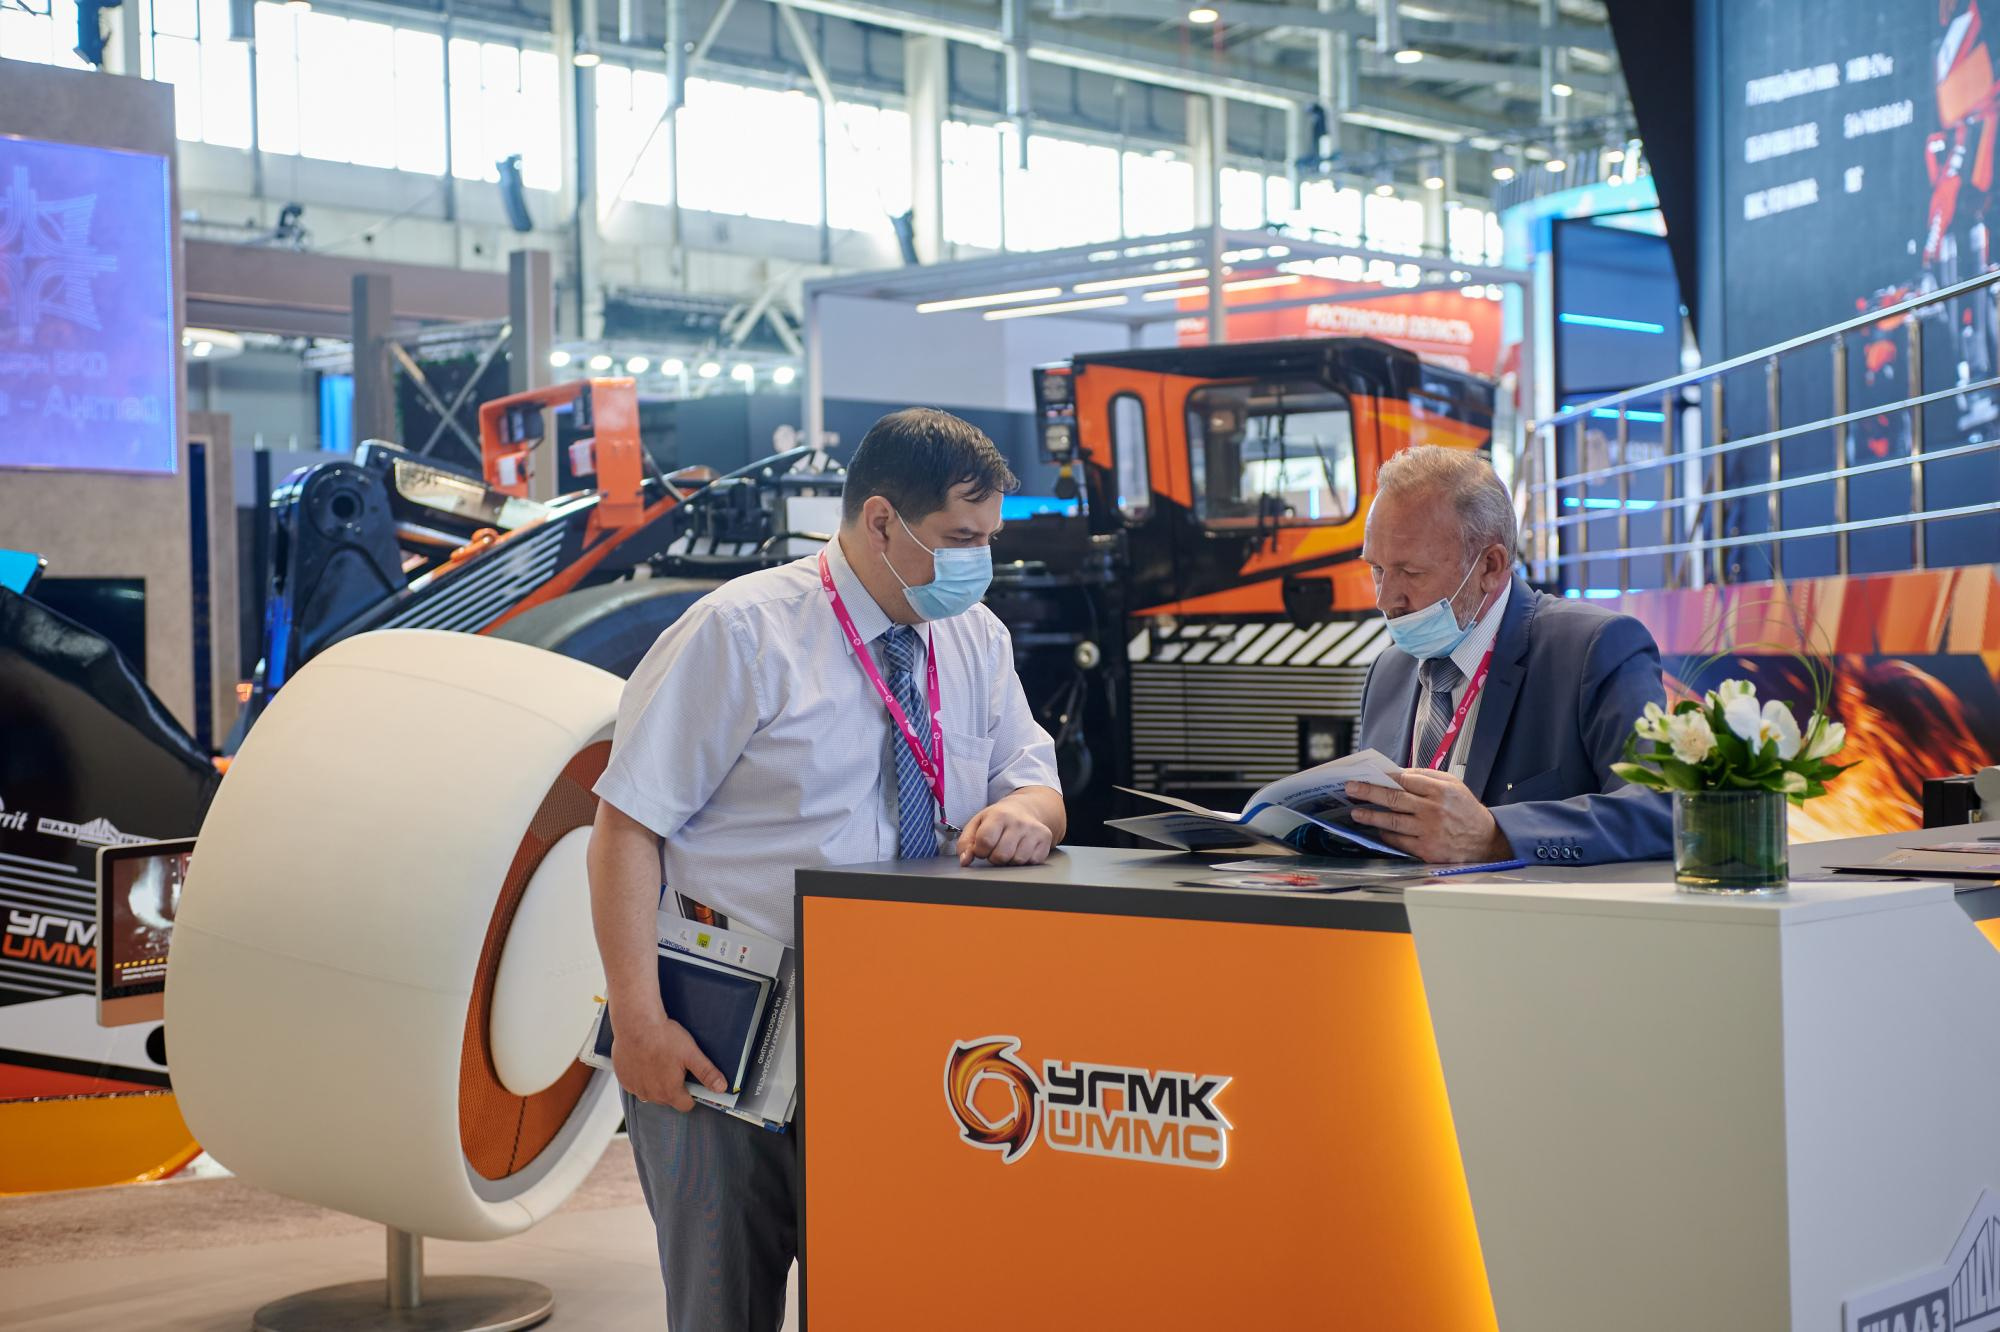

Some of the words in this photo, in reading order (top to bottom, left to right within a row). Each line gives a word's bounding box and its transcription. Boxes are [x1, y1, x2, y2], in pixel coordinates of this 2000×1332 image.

[6, 910, 96, 946] УГМ
[2, 933, 96, 970] UMM
[774, 997, 782, 1008] НА
[785, 969, 796, 998] ОЛУЧИ
[757, 1008, 778, 1064] РОБОТИЗАЦИЮ
[771, 999, 789, 1044] ПОДДЕРЖКУ
[754, 1045, 777, 1096] ГОСУДАРСТВА
[1047, 1066, 1219, 1121] УГМК
[1048, 1109, 1220, 1163] UMMC
